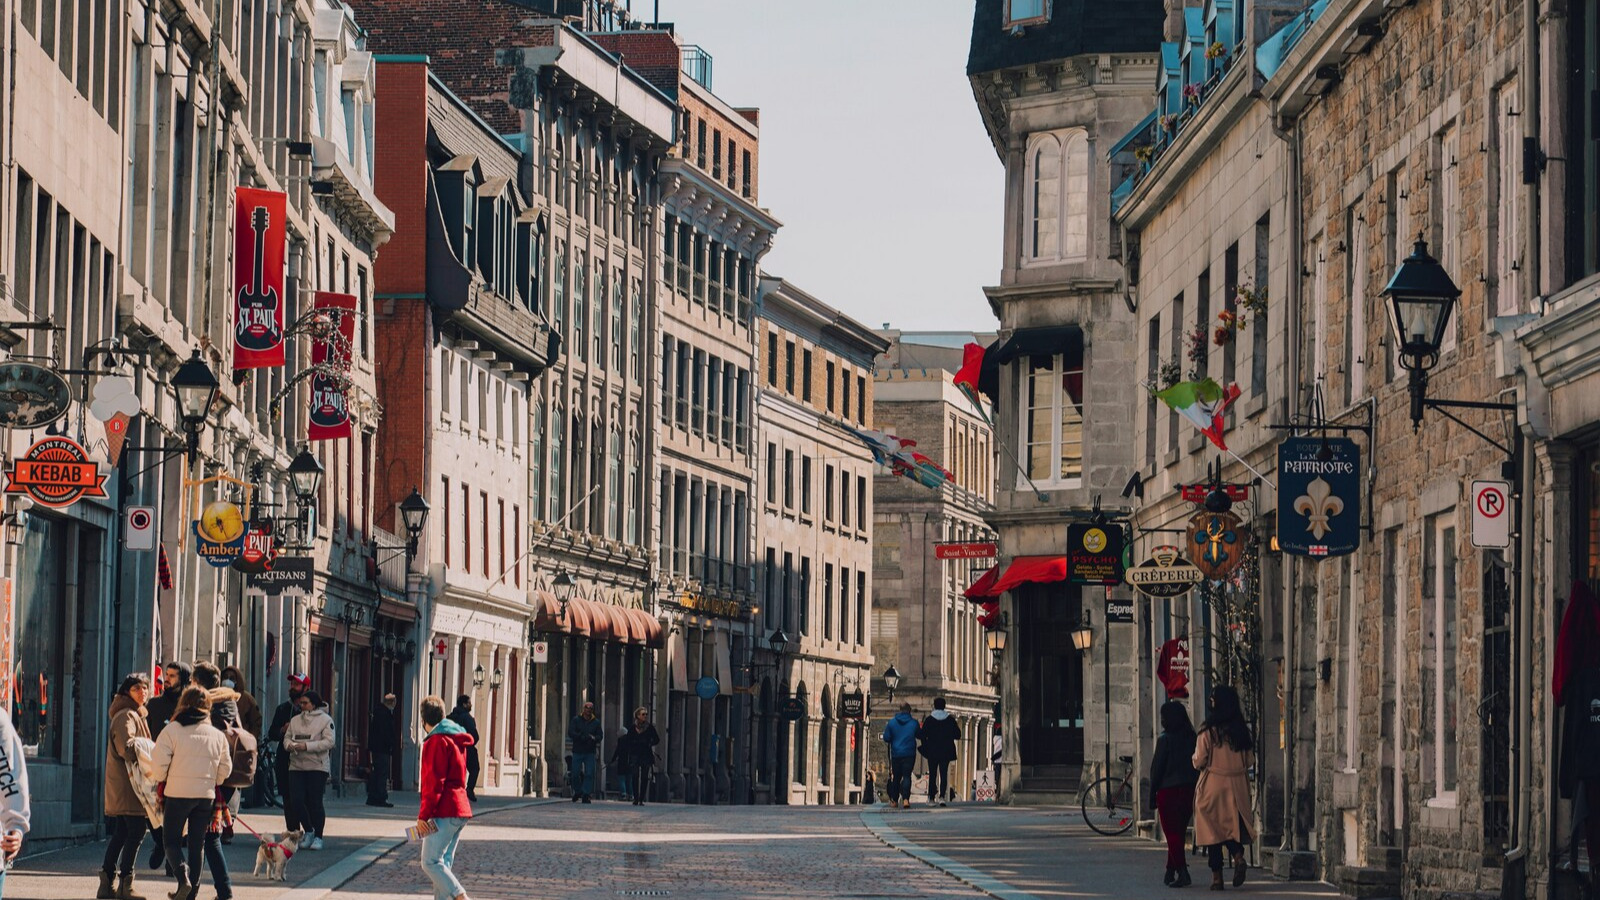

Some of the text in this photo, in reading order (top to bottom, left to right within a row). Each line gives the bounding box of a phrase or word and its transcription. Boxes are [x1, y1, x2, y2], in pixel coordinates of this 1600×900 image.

[239, 307, 278, 337] ST. PAUL
[313, 390, 323, 414] ST.
[30, 440, 82, 461] MONTREAL
[29, 463, 82, 482] KEBAB
[1284, 460, 1354, 474] PATRIOTE
[1486, 493, 1498, 512] P
[199, 542, 241, 556] Amber
[1072, 556, 1117, 564] PSYCHO
[254, 571, 306, 581] ARTISANS
[1132, 568, 1200, 582] CRÊPERIE
